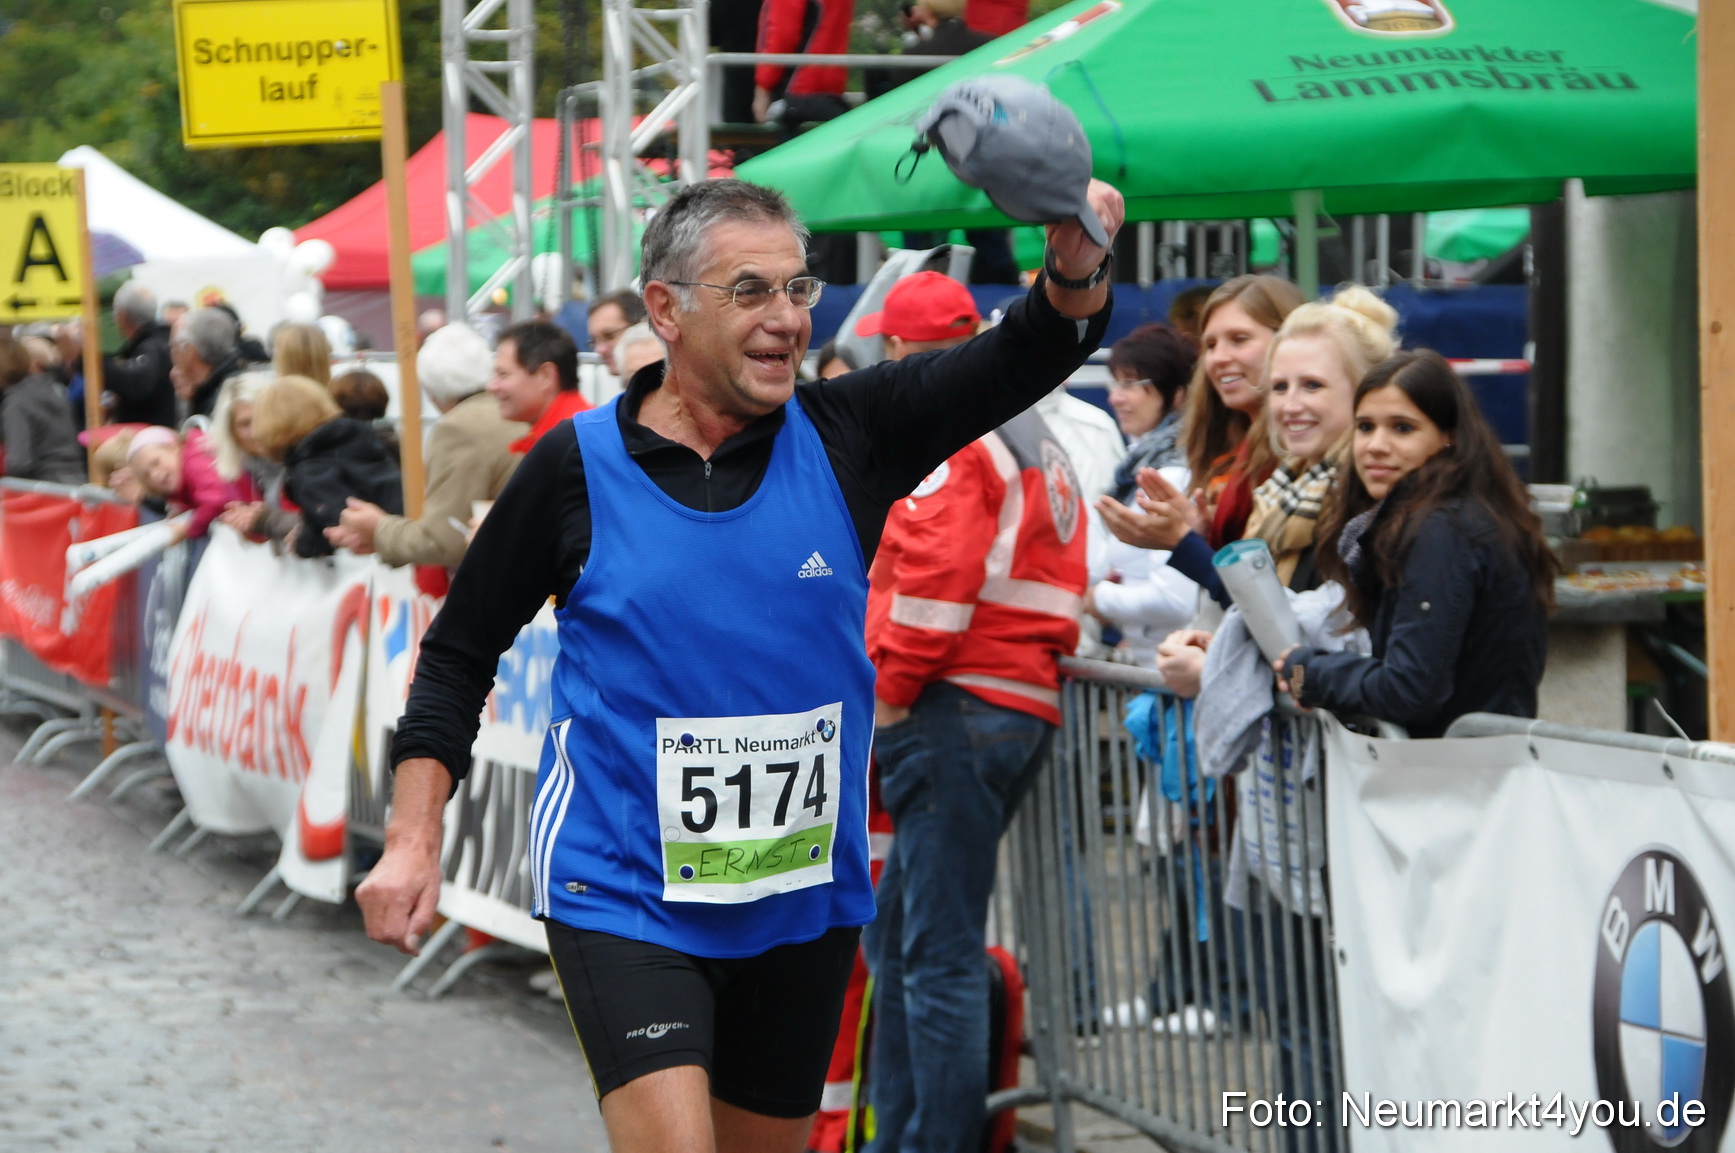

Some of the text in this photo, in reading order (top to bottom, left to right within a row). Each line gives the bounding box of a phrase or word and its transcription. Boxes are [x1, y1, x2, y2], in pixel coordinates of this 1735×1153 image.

[193, 36, 378, 67] Schnupper-
[1290, 44, 1565, 71] Neumarkter
[259, 72, 318, 102] lauf
[1251, 65, 1640, 102] Lammsbräu
[14, 214, 68, 282] A
[797, 567, 833, 578] adidas
[166, 600, 312, 783] Oberbank
[662, 731, 816, 754] PARTL Neumarkt
[680, 753, 828, 834] 5174
[699, 838, 806, 878] ERNST
[1601, 856, 1725, 985] BMW
[626, 1027, 645, 1039] PRO
